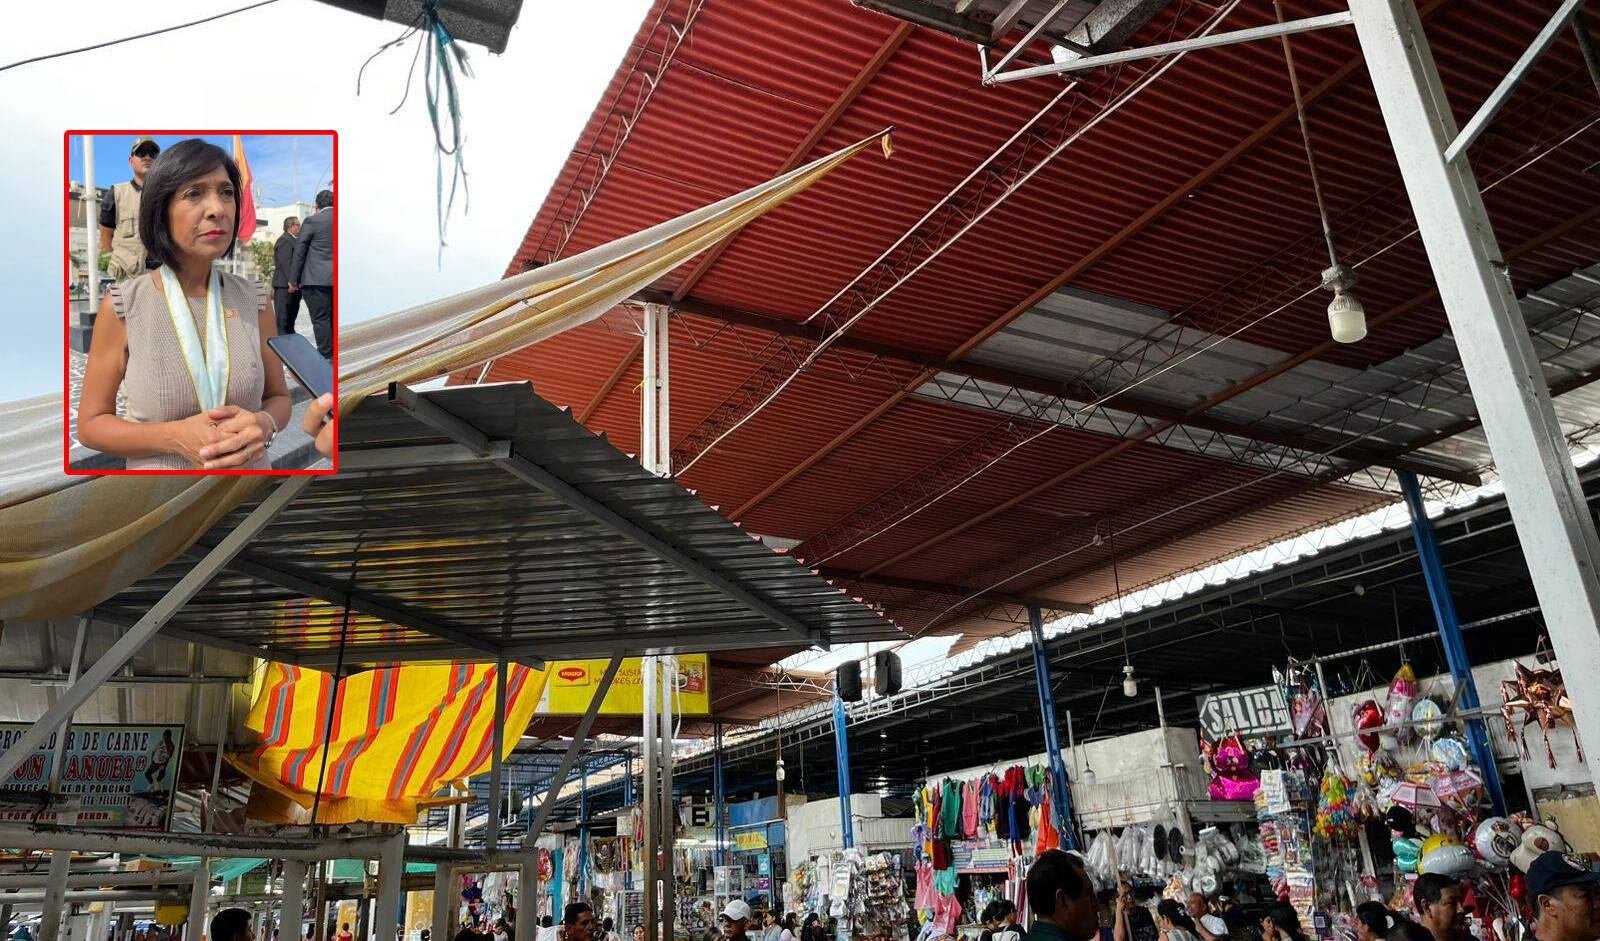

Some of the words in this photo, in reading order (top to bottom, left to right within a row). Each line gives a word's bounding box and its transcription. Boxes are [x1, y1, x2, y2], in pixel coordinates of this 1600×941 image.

[1208, 691, 1287, 733] SALIDA
[82, 731, 100, 751] DE
[106, 731, 149, 751] CARNE
[75, 784, 86, 793] DE
[89, 784, 131, 793] PORCINO
